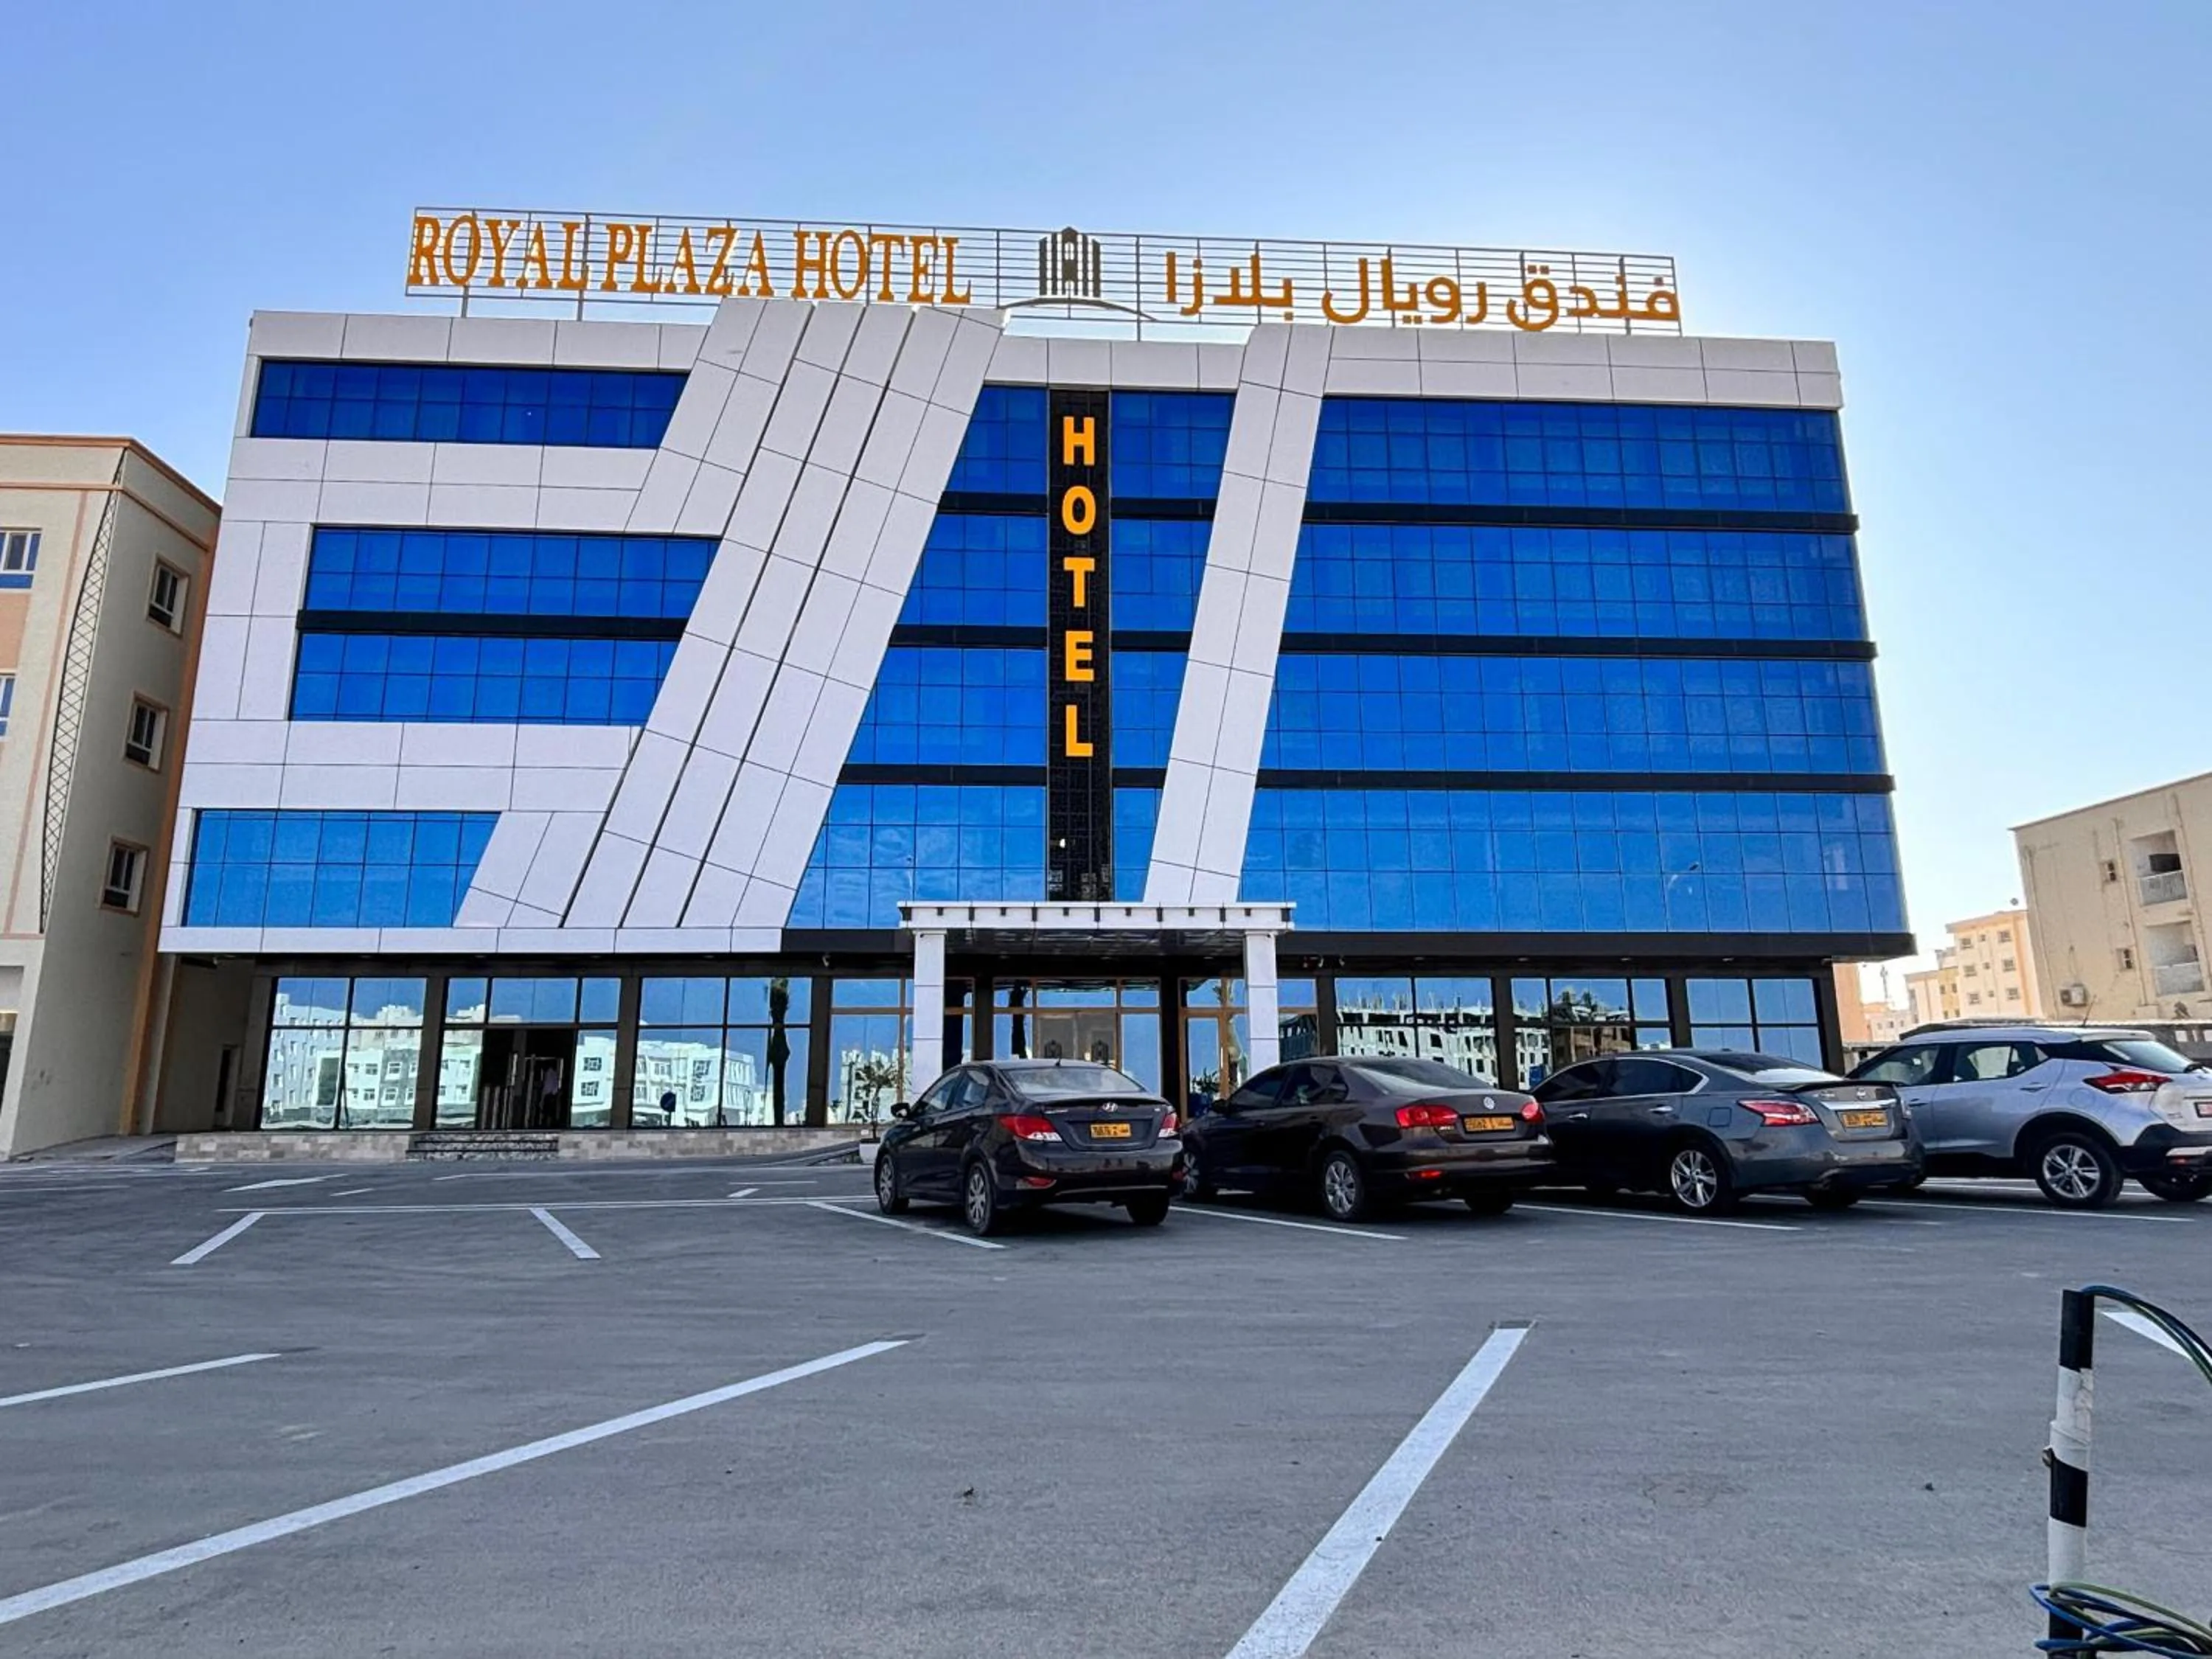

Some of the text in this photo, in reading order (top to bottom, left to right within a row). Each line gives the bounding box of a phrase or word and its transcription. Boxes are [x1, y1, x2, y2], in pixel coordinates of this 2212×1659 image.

[407, 215, 971, 305] ROYAL PLAZA HOTEL
[1321, 257, 1488, 324] رويال
[1506, 264, 1681, 333] فندق
[1062, 416, 1097, 758] HOTEL
